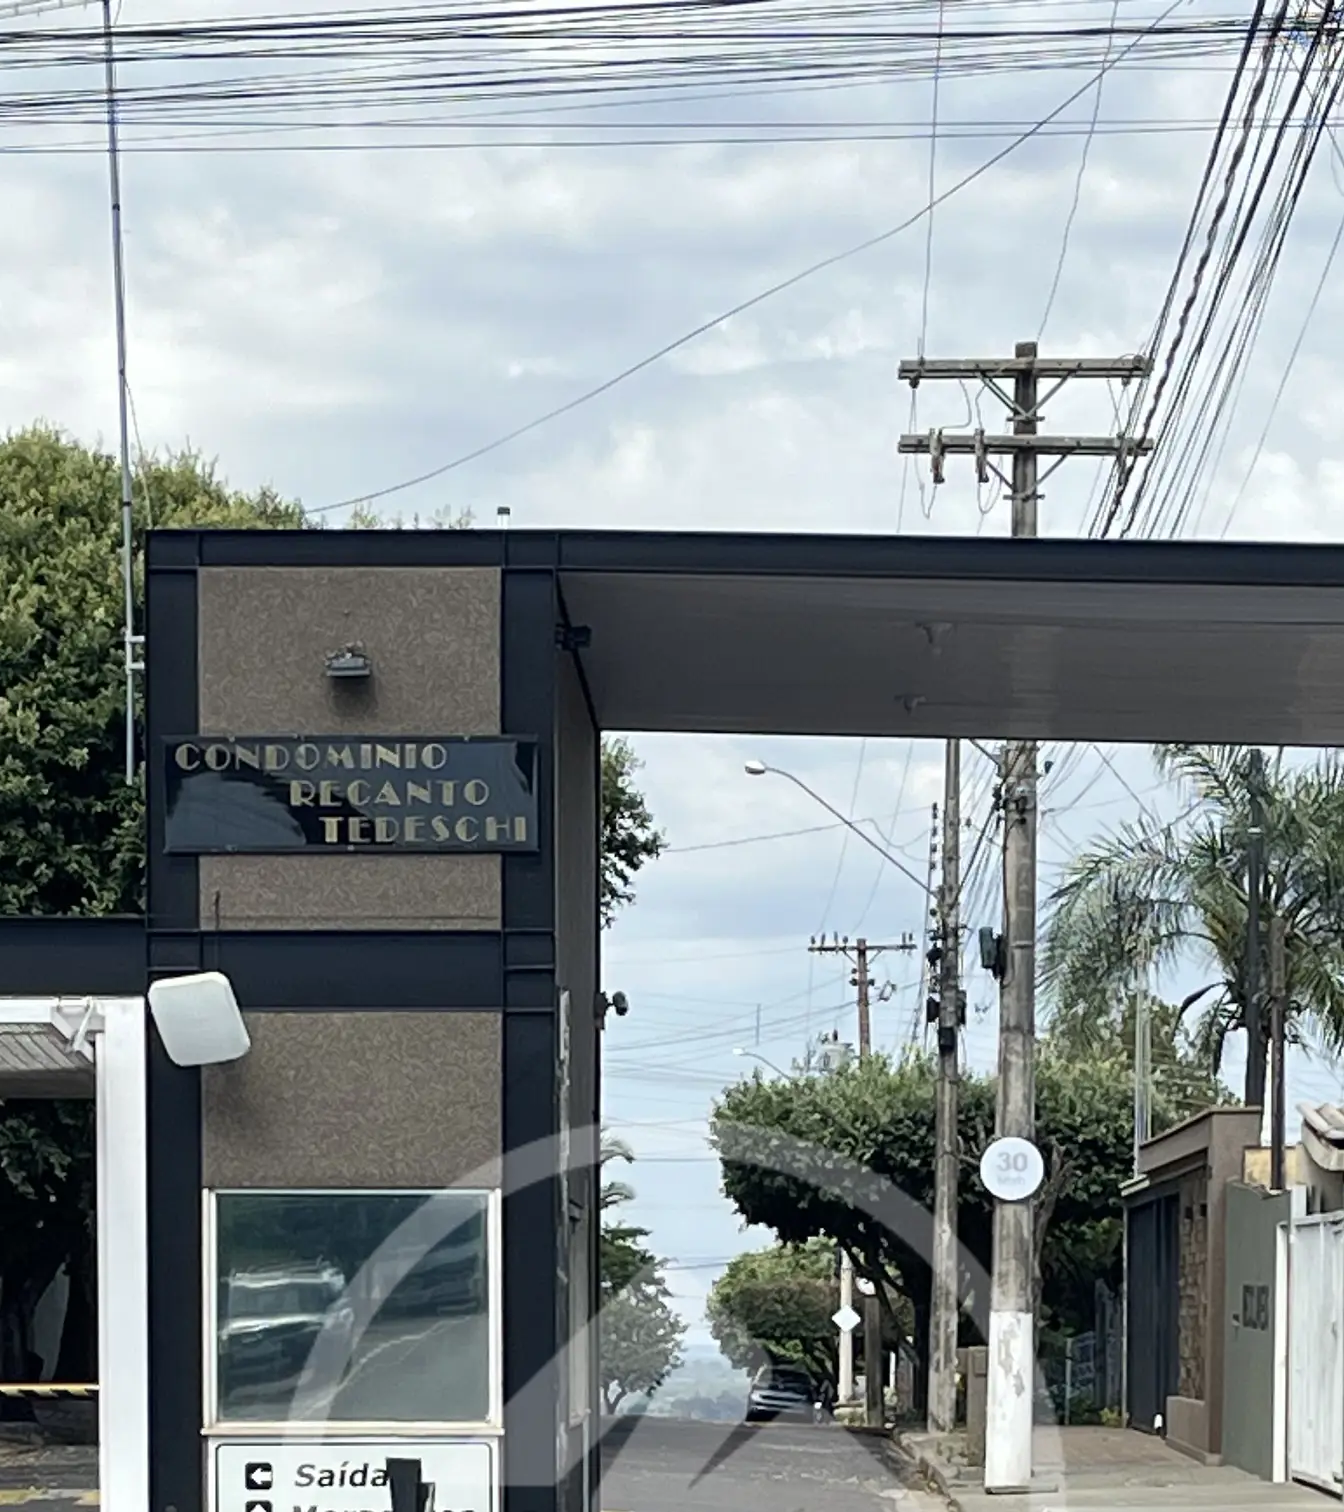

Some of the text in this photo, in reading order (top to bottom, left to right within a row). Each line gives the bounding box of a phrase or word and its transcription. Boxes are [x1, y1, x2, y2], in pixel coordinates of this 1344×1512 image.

[174, 743, 448, 771] CONDOMINIO
[289, 779, 490, 806] RECANTO
[318, 816, 528, 843] TEDESCHI
[996, 1151, 1028, 1173] 30
[294, 1461, 390, 1488] Saída
